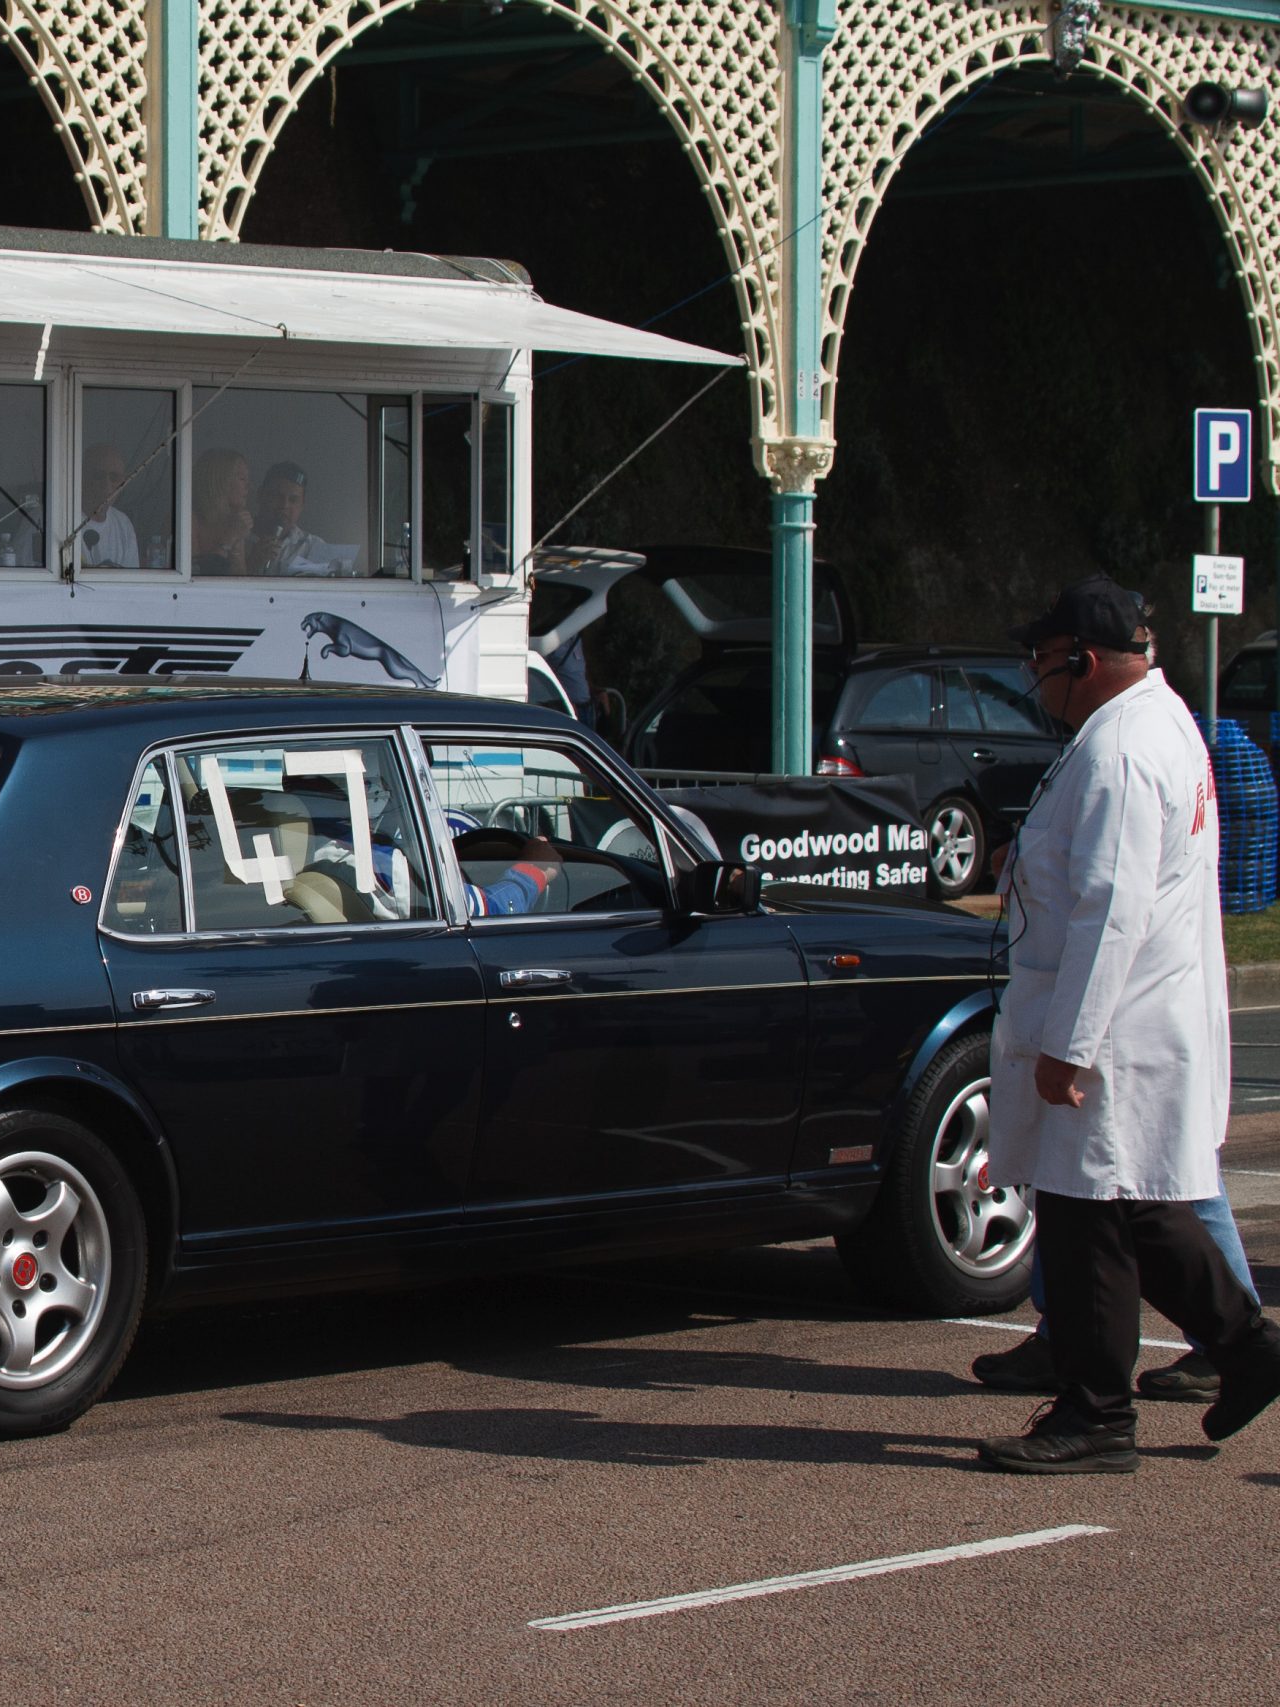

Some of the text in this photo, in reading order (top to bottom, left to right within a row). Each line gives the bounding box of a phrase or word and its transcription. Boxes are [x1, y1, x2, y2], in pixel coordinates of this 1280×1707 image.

[1208, 420, 1241, 491] P
[201, 749, 376, 905] 47
[741, 825, 879, 862] Goodwood
